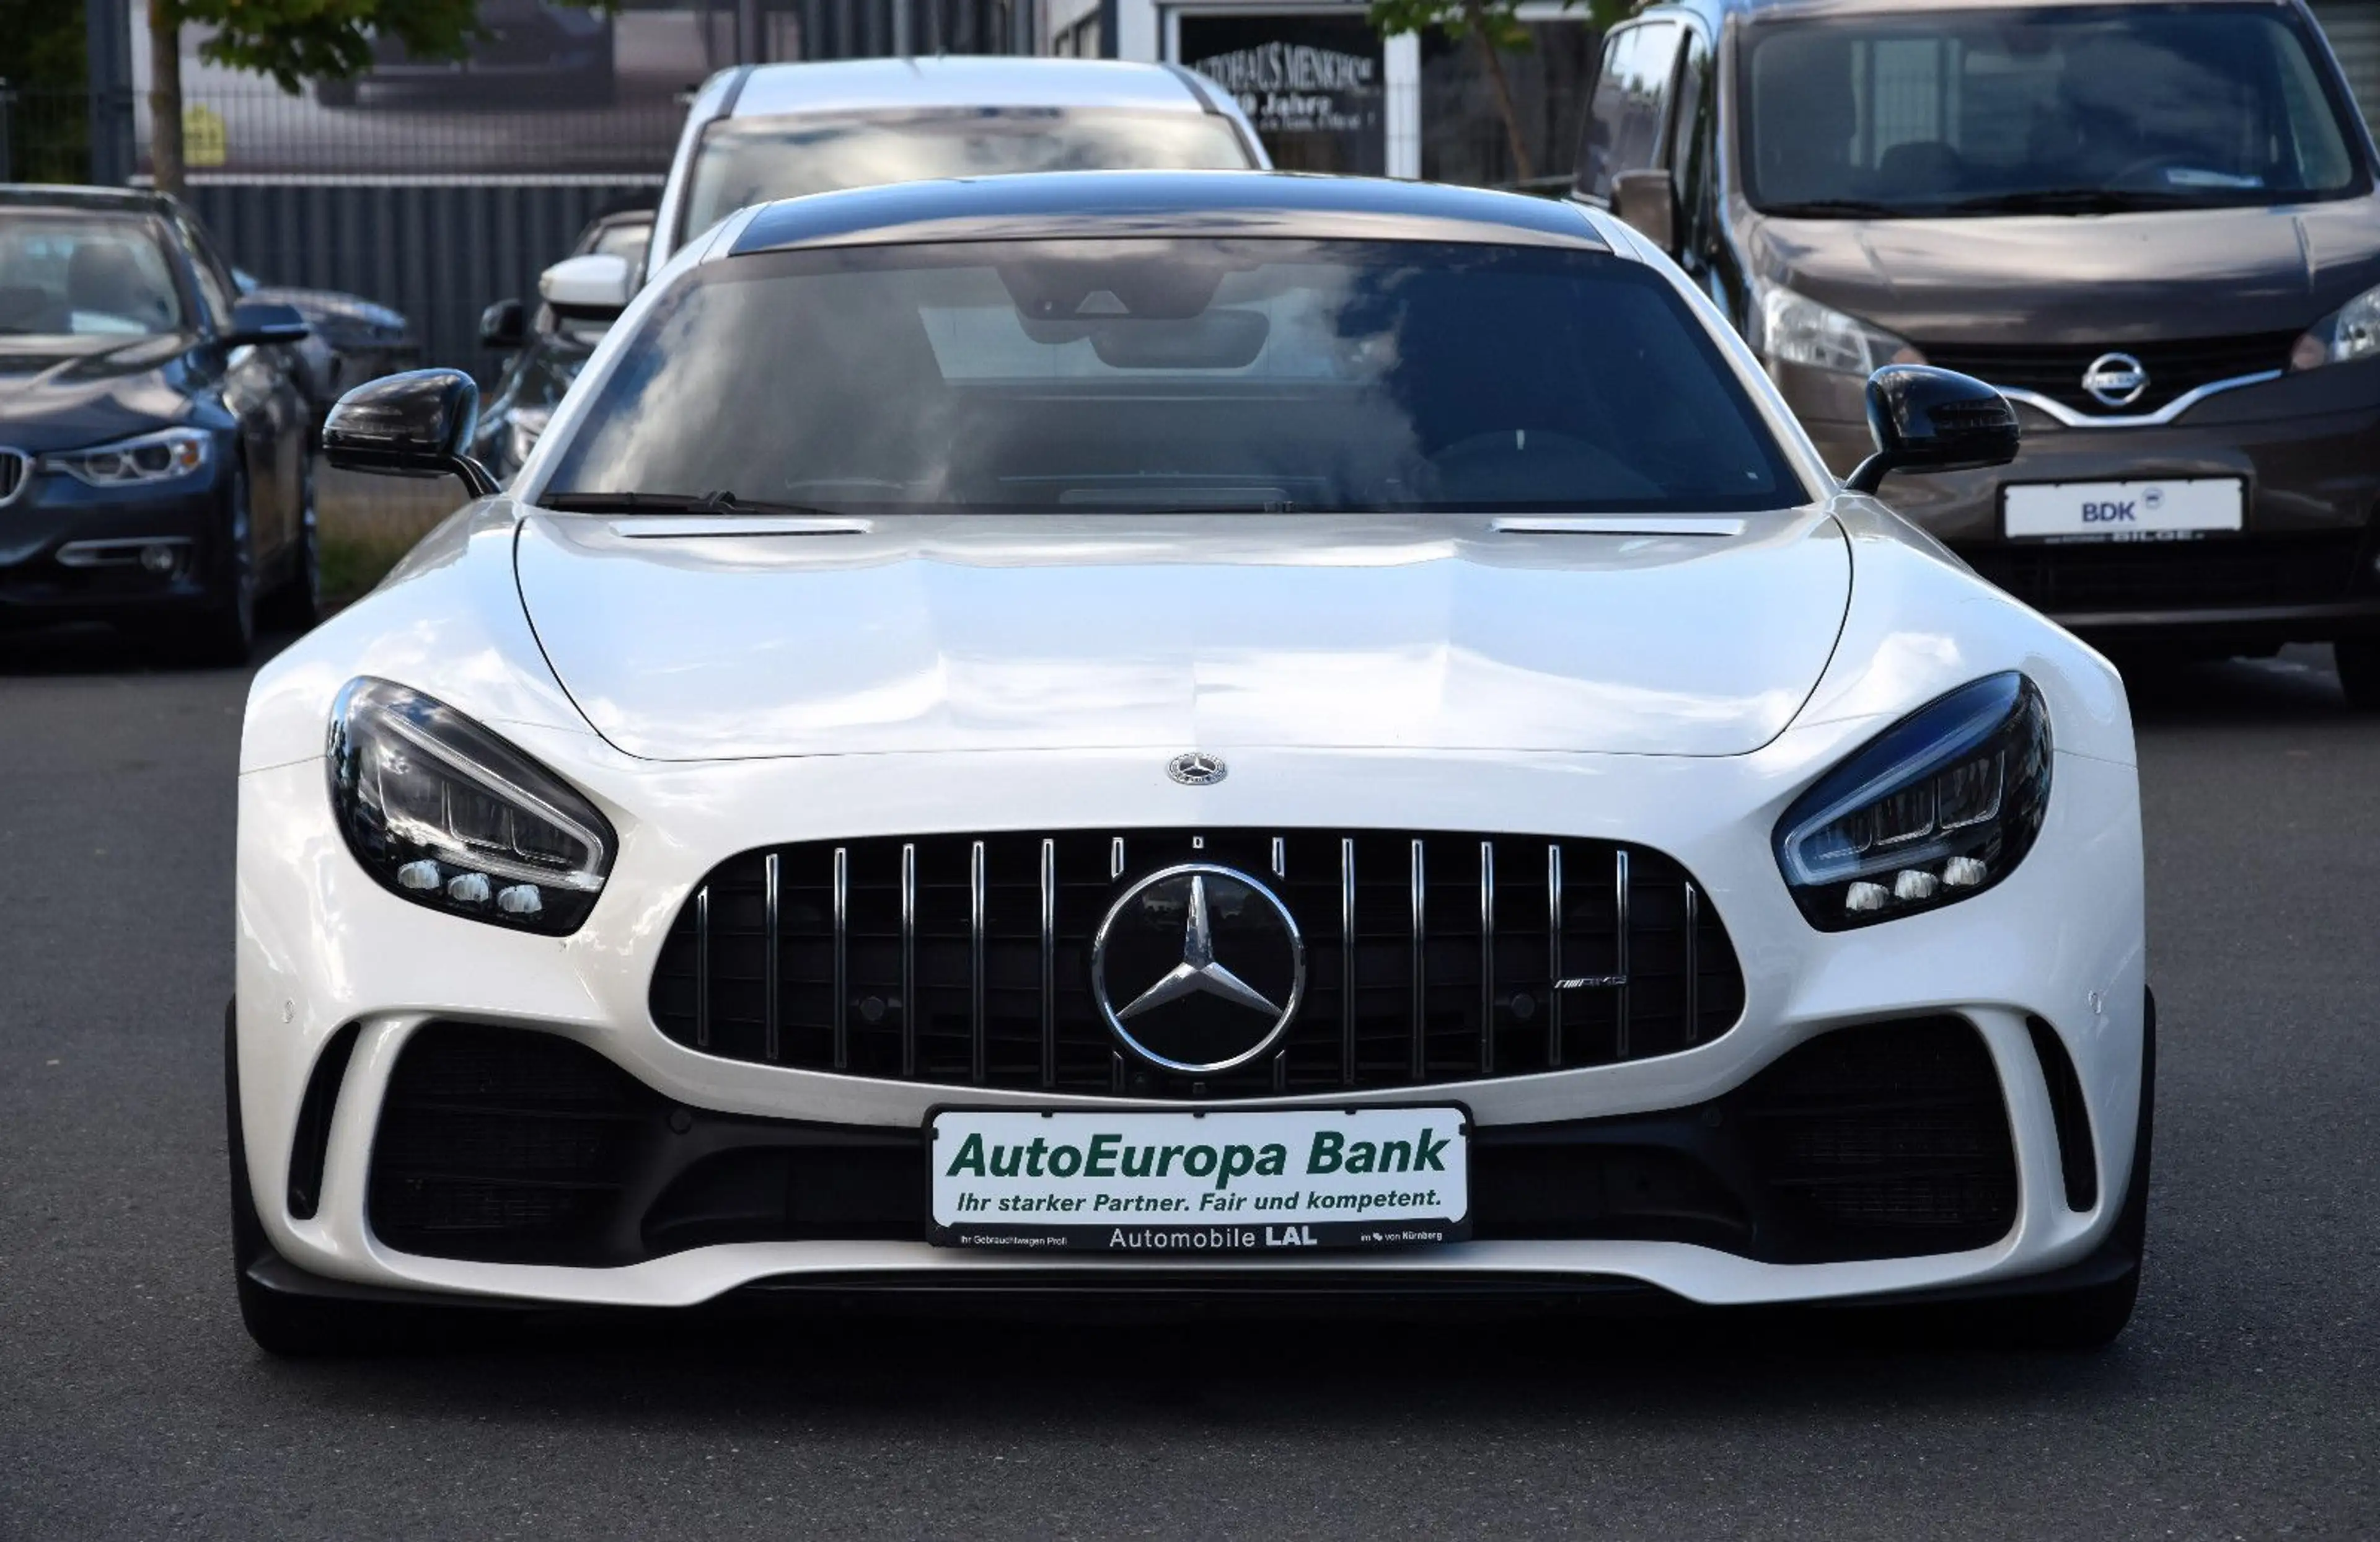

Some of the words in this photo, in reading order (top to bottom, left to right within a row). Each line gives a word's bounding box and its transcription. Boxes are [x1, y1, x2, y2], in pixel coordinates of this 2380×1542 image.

[2082, 501, 2135, 522] BDK
[945, 1133, 1287, 1190] AutoEuropa
[1306, 1128, 1451, 1174] Bank
[957, 1192, 992, 1212] Ihr
[998, 1194, 1086, 1212] starker
[1093, 1194, 1189, 1212] Partner.
[1199, 1192, 1248, 1212] Fair
[1254, 1191, 1300, 1210] und
[1307, 1189, 1442, 1213] kompetent.
[1109, 1228, 1255, 1248] Automobile
[1266, 1226, 1318, 1246] LAL
[1385, 1233, 1400, 1242] von
